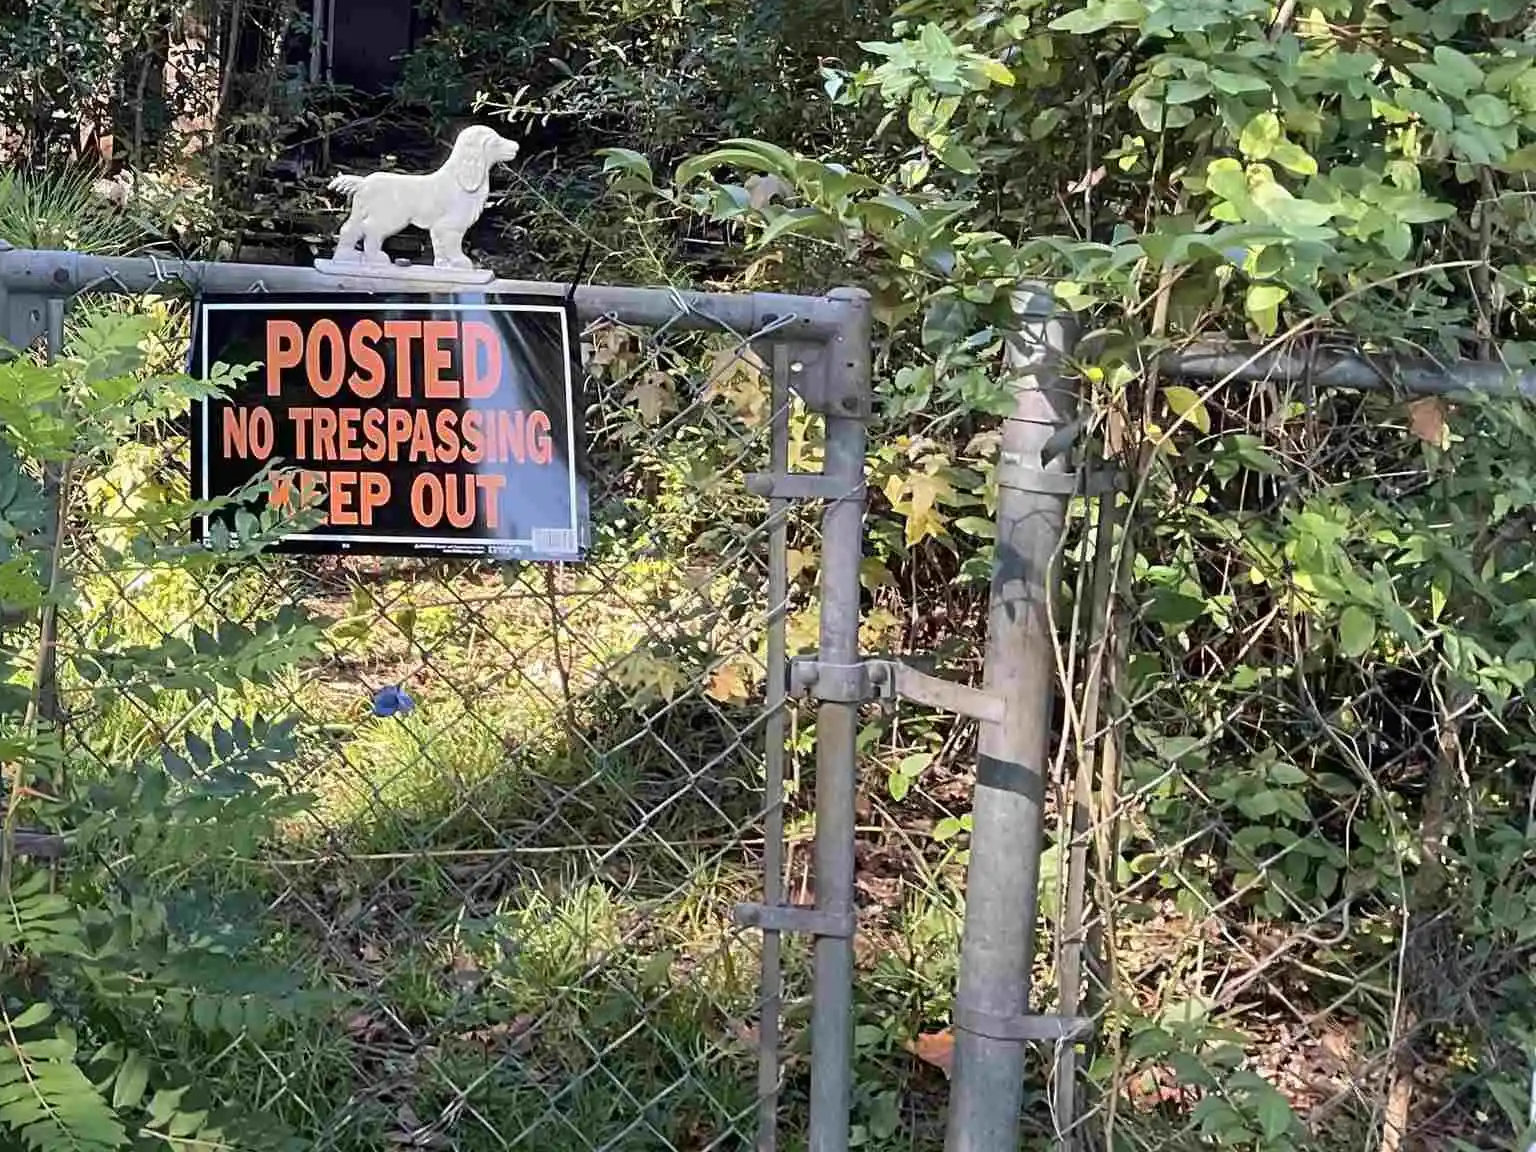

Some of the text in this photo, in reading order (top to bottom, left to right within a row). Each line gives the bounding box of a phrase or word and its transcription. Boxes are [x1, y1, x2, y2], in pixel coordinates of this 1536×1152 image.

[267, 319, 502, 398] POSTED
[223, 407, 553, 465] NO TRESPASSING
[411, 472, 506, 529] OUT
